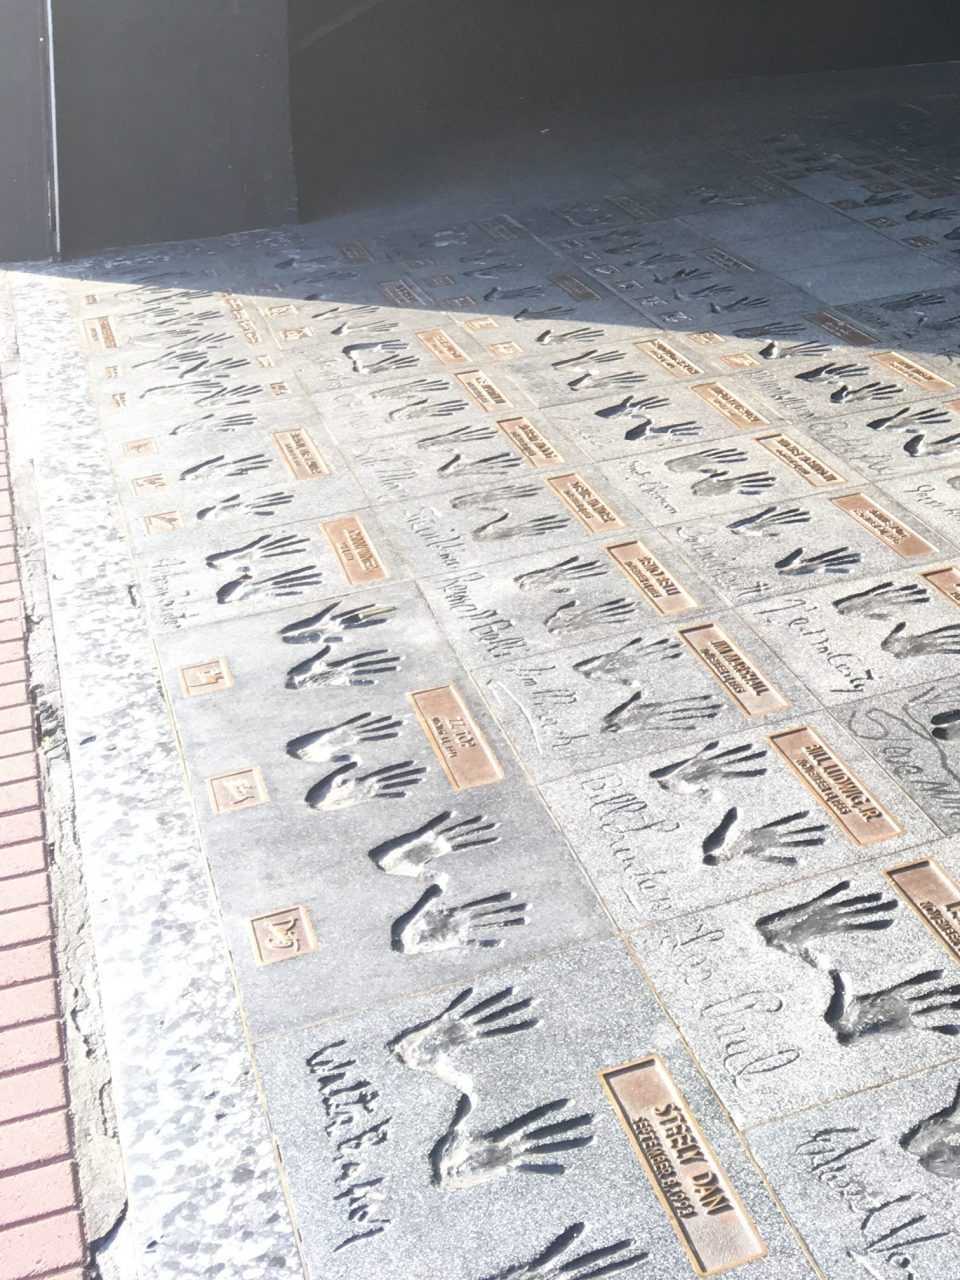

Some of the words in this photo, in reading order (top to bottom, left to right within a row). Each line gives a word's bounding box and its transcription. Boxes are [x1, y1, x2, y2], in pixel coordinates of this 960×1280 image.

[801, 743, 835, 766] BILL
[630, 1114, 676, 1180] SEPTEMBER
[649, 1100, 707, 1168] STEELY
[687, 1168, 735, 1220] DAN
